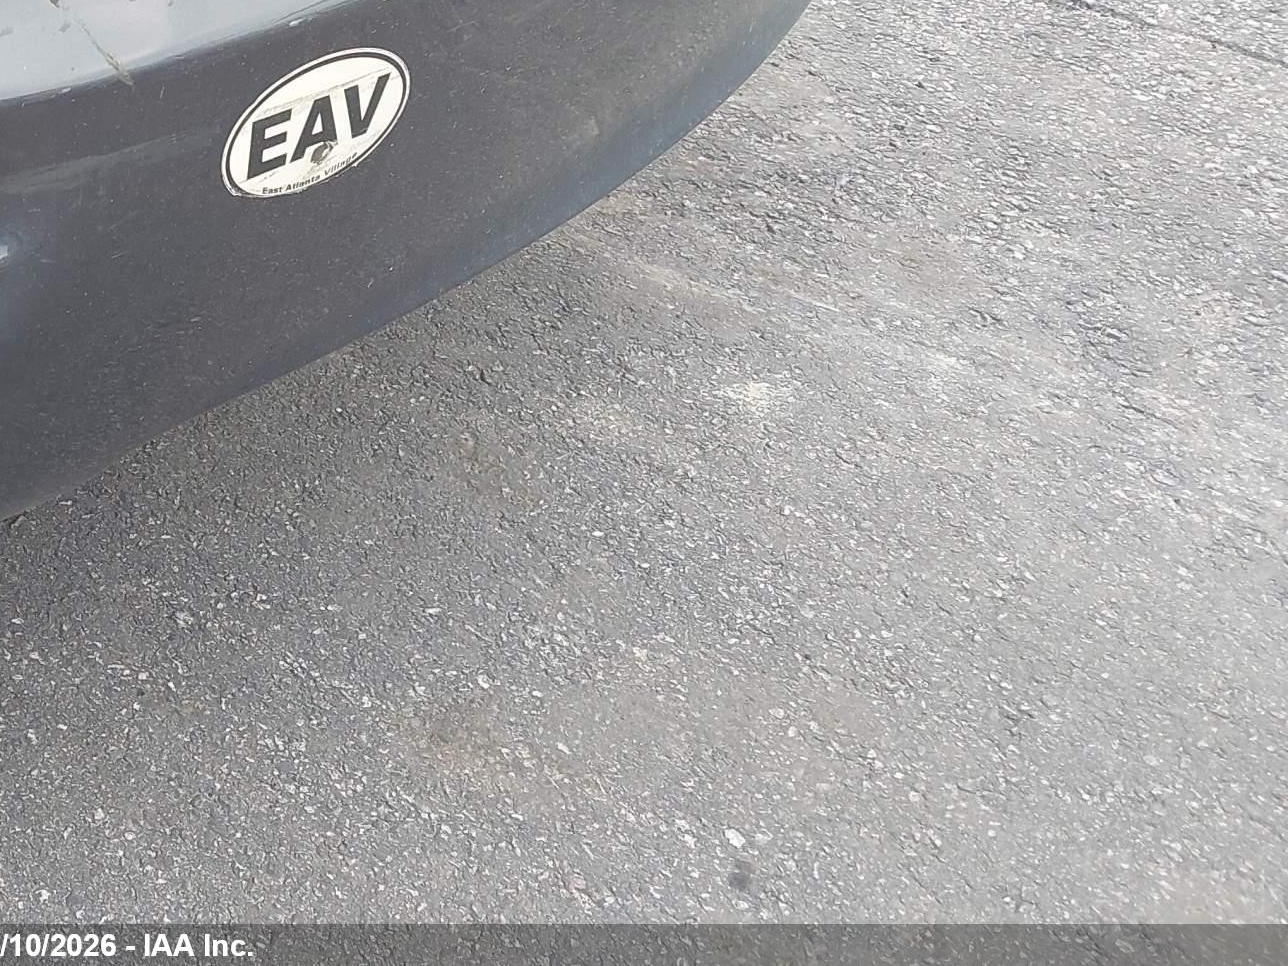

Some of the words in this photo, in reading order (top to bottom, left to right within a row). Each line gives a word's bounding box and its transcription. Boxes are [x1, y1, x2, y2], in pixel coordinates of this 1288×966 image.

[246, 72, 392, 180] EAV
[262, 185, 283, 195] East
[285, 174, 321, 192] Atlanta
